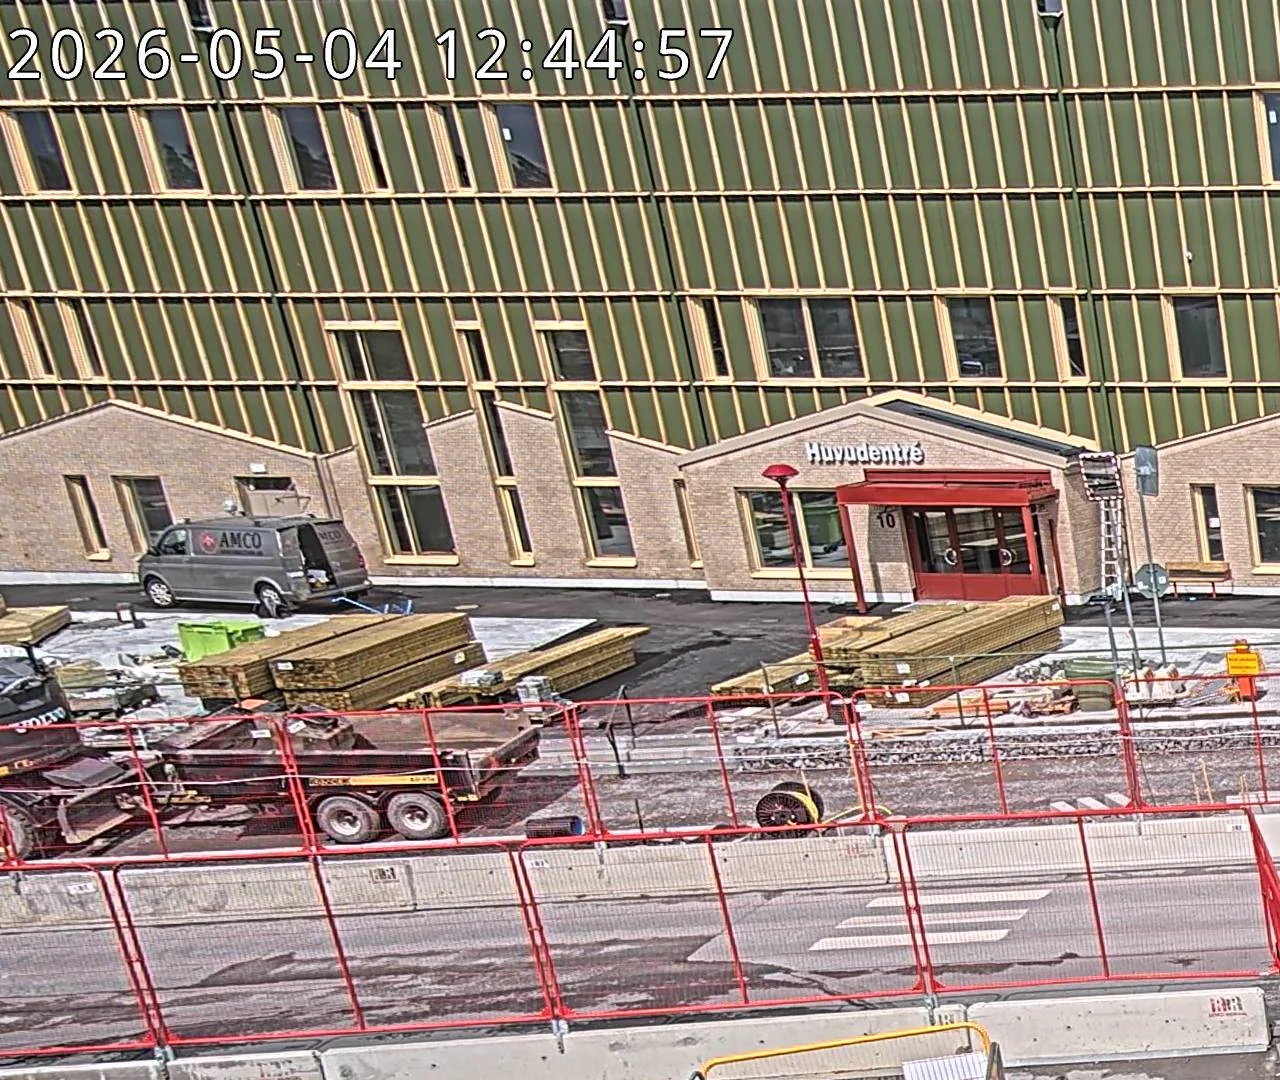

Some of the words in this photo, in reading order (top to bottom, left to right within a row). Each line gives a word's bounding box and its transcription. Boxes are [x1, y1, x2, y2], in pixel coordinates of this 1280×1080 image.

[805, 441, 924, 465] Huvudentré
[877, 512, 896, 529] 10
[220, 531, 262, 549] AMCO
